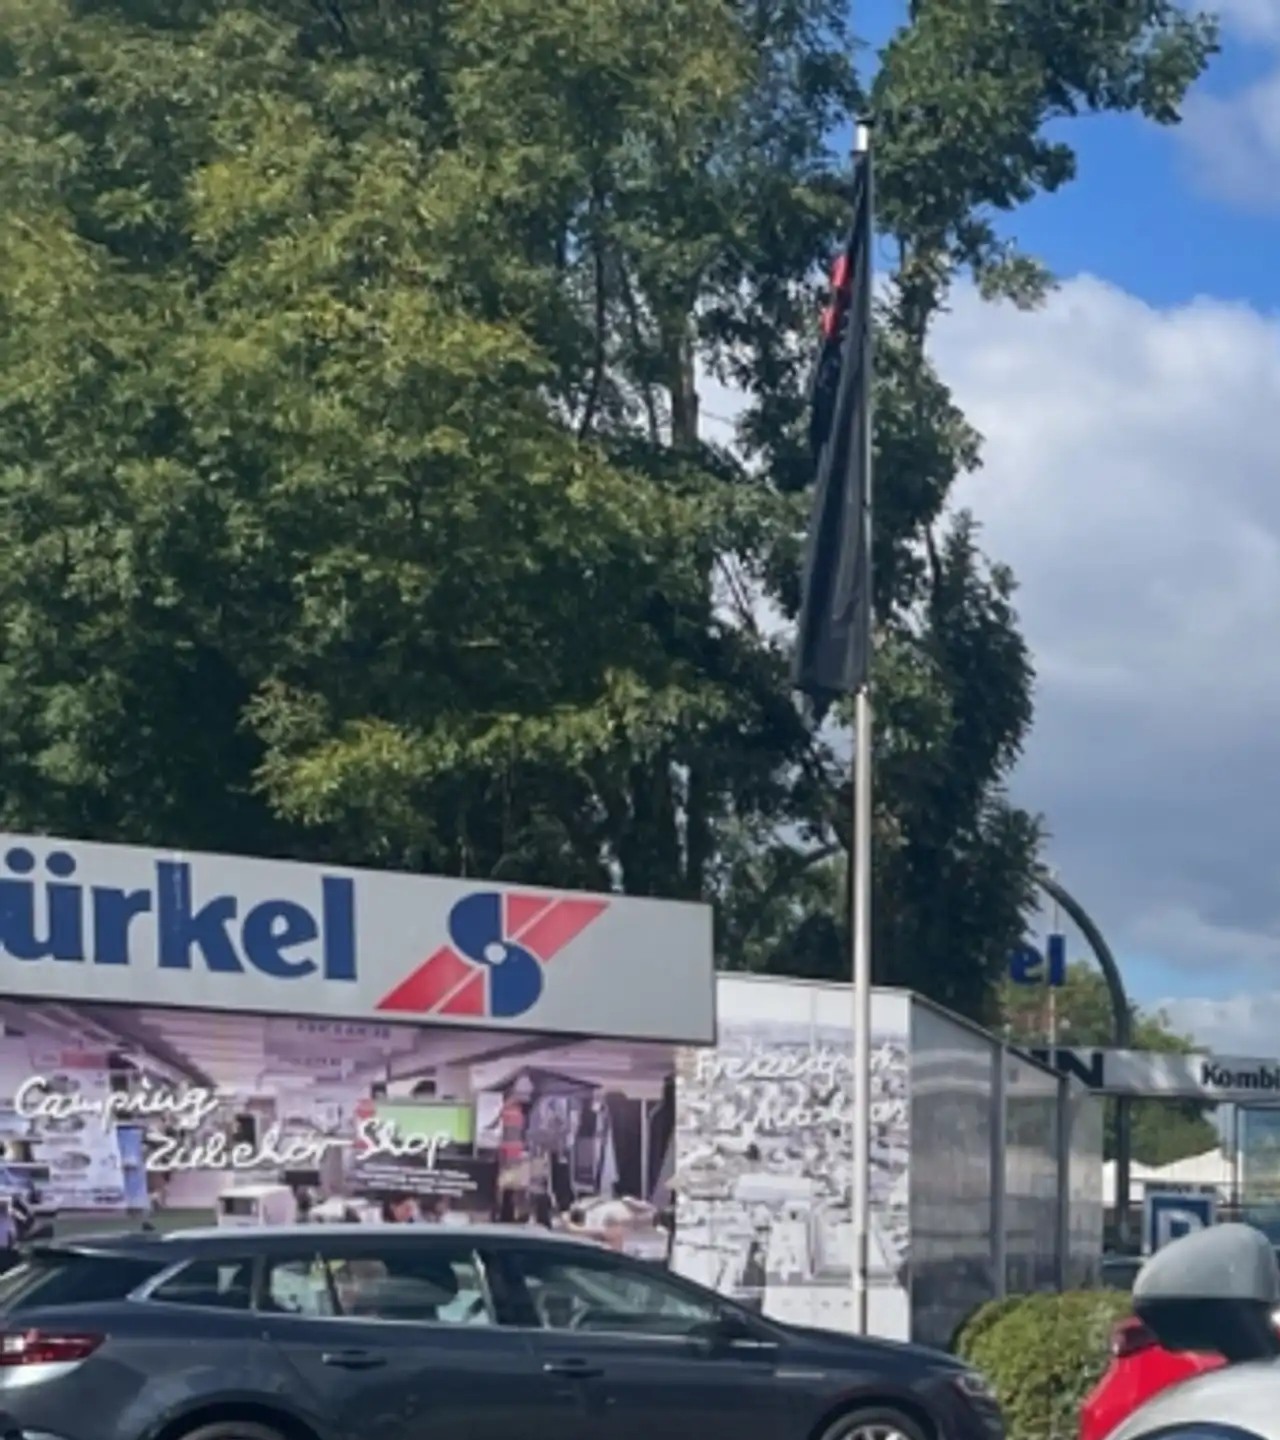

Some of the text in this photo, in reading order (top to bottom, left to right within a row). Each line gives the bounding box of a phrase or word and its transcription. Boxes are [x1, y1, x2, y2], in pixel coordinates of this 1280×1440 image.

[0, 847, 357, 982] ürkel
[14, 1075, 220, 1136] Camping
[355, 1117, 452, 1171] Shop
